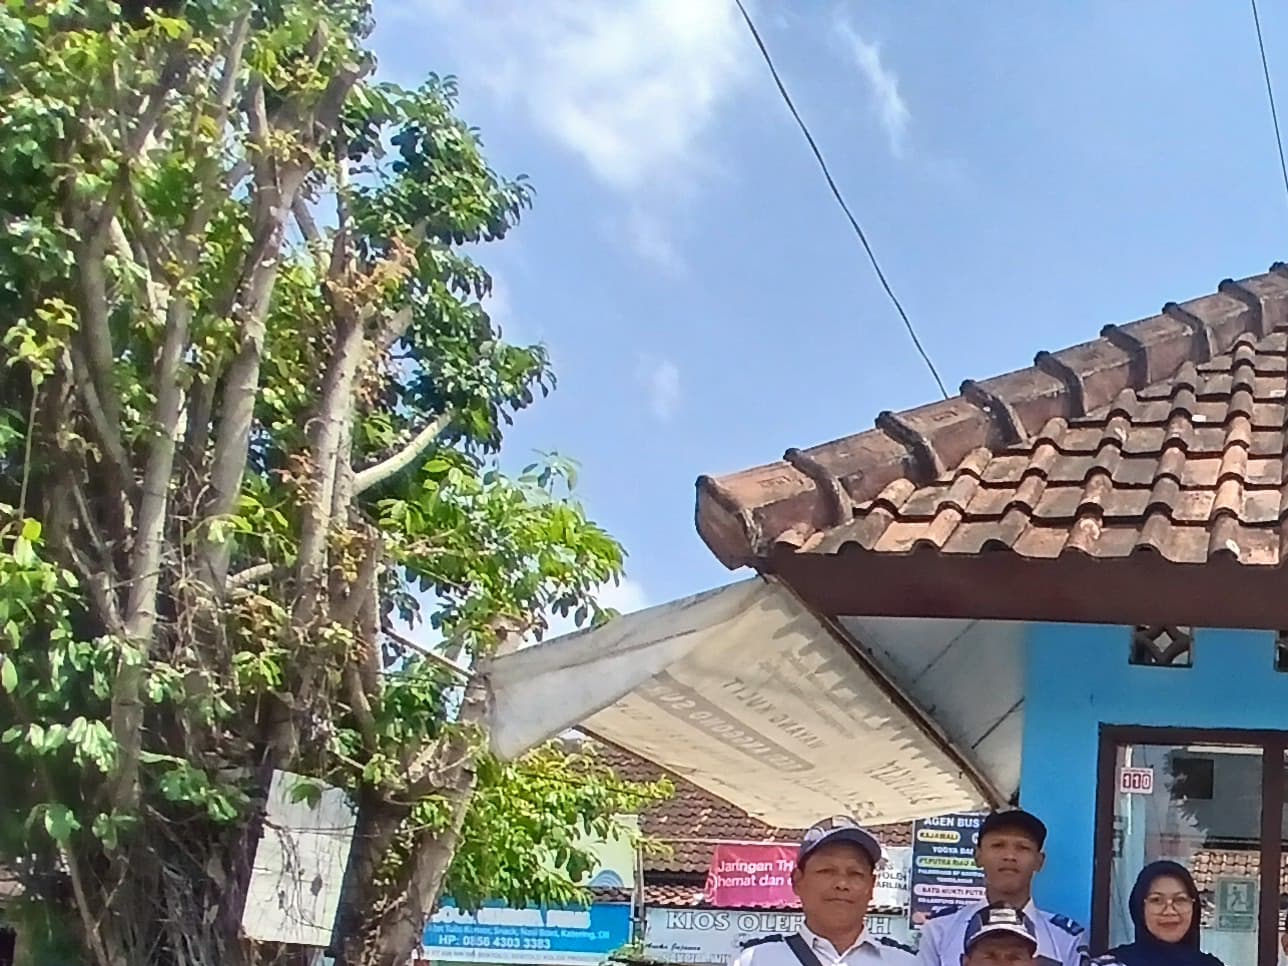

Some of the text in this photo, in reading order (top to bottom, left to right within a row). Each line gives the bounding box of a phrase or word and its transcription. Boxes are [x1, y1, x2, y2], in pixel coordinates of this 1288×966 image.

[1123, 773, 1151, 790] 110
[924, 817, 980, 828] AGEN BUS
[718, 861, 773, 874] Jaringan
[717, 875, 756, 887] hemat
[758, 874, 785, 886] dan
[667, 911, 730, 931] KIOS
[438, 934, 460, 946] HP:
